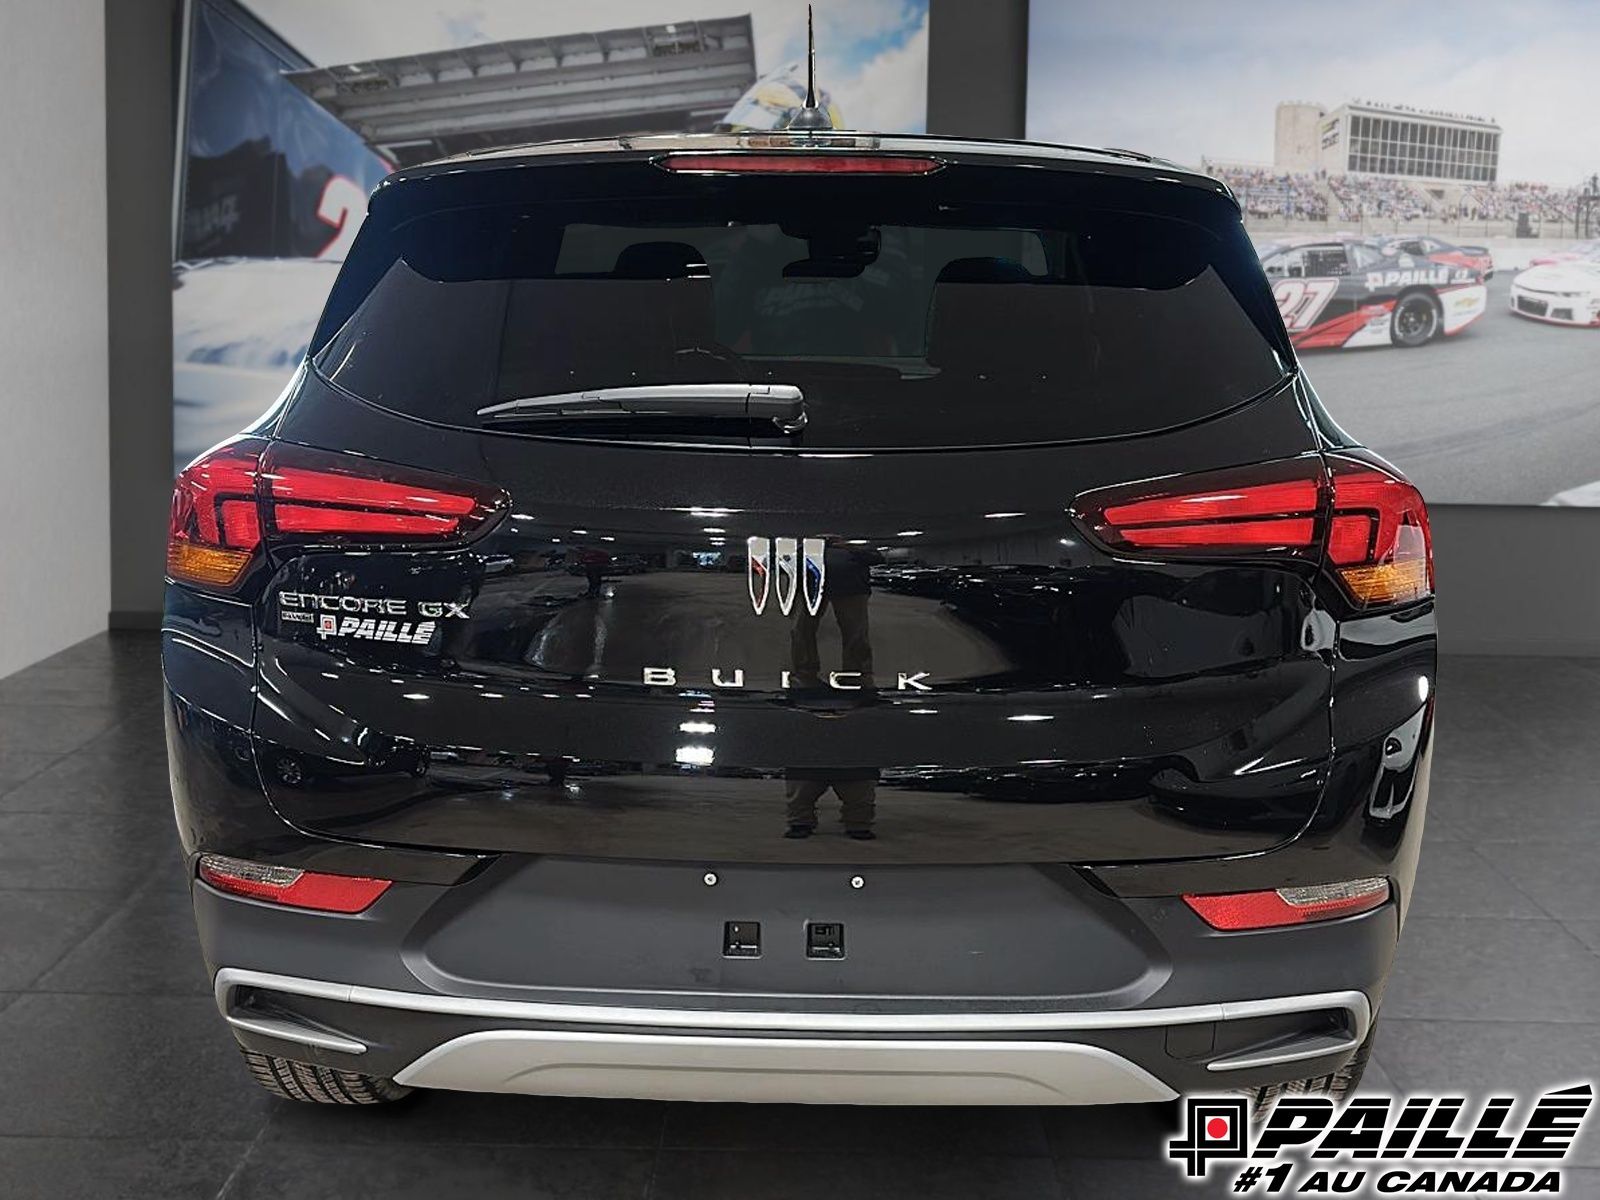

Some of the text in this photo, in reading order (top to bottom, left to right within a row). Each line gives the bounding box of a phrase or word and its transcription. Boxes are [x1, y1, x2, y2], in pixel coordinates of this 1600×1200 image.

[279, 590, 470, 619] ENCORE GX
[643, 667, 933, 691] BUICK
